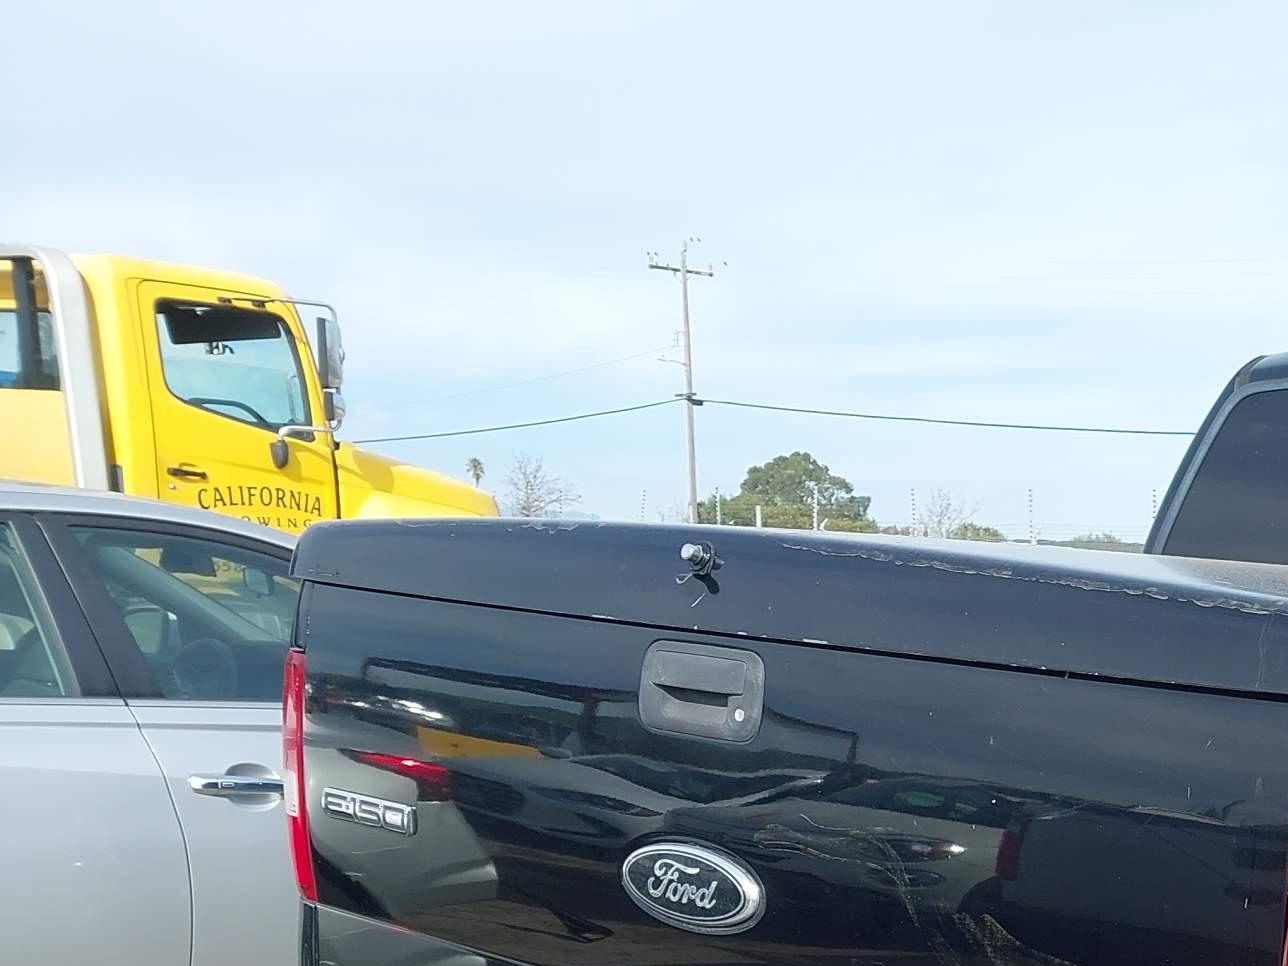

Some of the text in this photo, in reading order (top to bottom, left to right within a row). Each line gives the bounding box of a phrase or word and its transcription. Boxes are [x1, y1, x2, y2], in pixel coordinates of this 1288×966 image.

[198, 486, 322, 517] CALIFORNIA
[241, 516, 313, 529] WING
[647, 859, 718, 909] Ford
